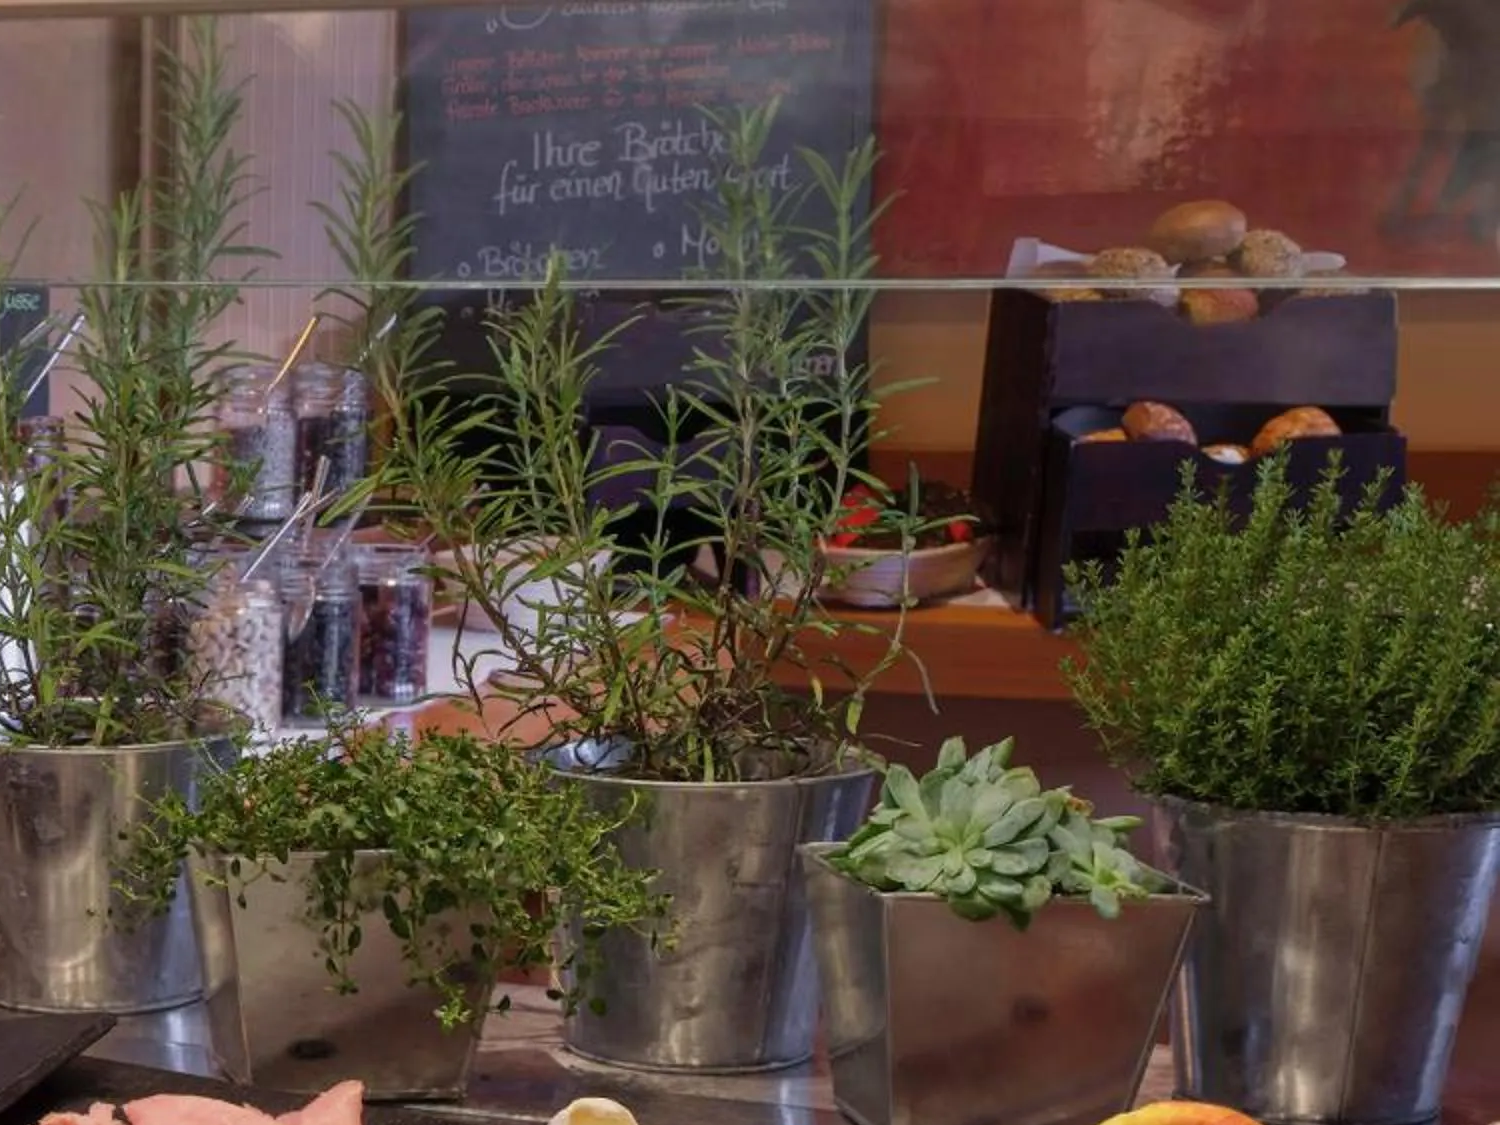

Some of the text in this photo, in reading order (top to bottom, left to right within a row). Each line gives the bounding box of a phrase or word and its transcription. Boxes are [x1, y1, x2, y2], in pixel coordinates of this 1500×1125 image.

[532, 129, 601, 171] Ihre
[492, 160, 541, 216] für
[550, 170, 623, 202] einen
